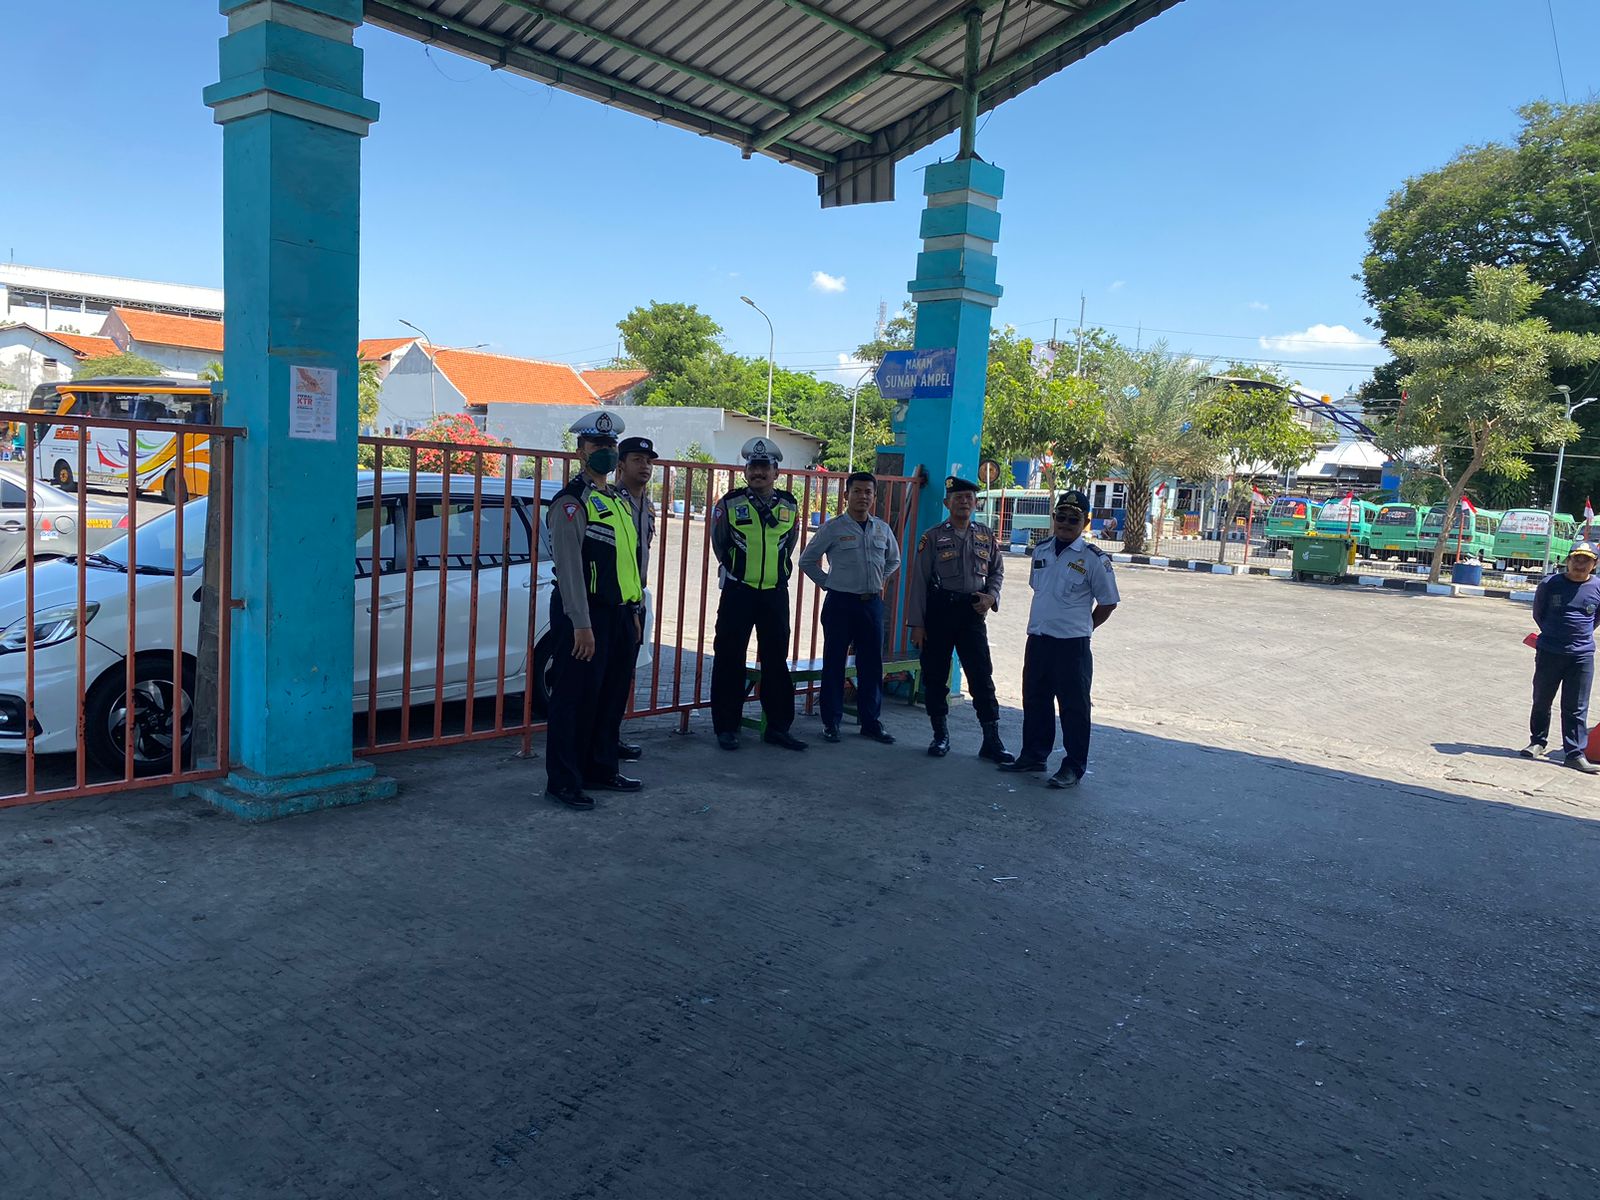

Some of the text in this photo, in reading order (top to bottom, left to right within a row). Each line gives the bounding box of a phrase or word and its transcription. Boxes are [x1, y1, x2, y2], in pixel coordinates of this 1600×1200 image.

[905, 358, 933, 370] MAKAM
[885, 373, 951, 388] SUNAN AMPEL
[297, 397, 313, 406] KTR
